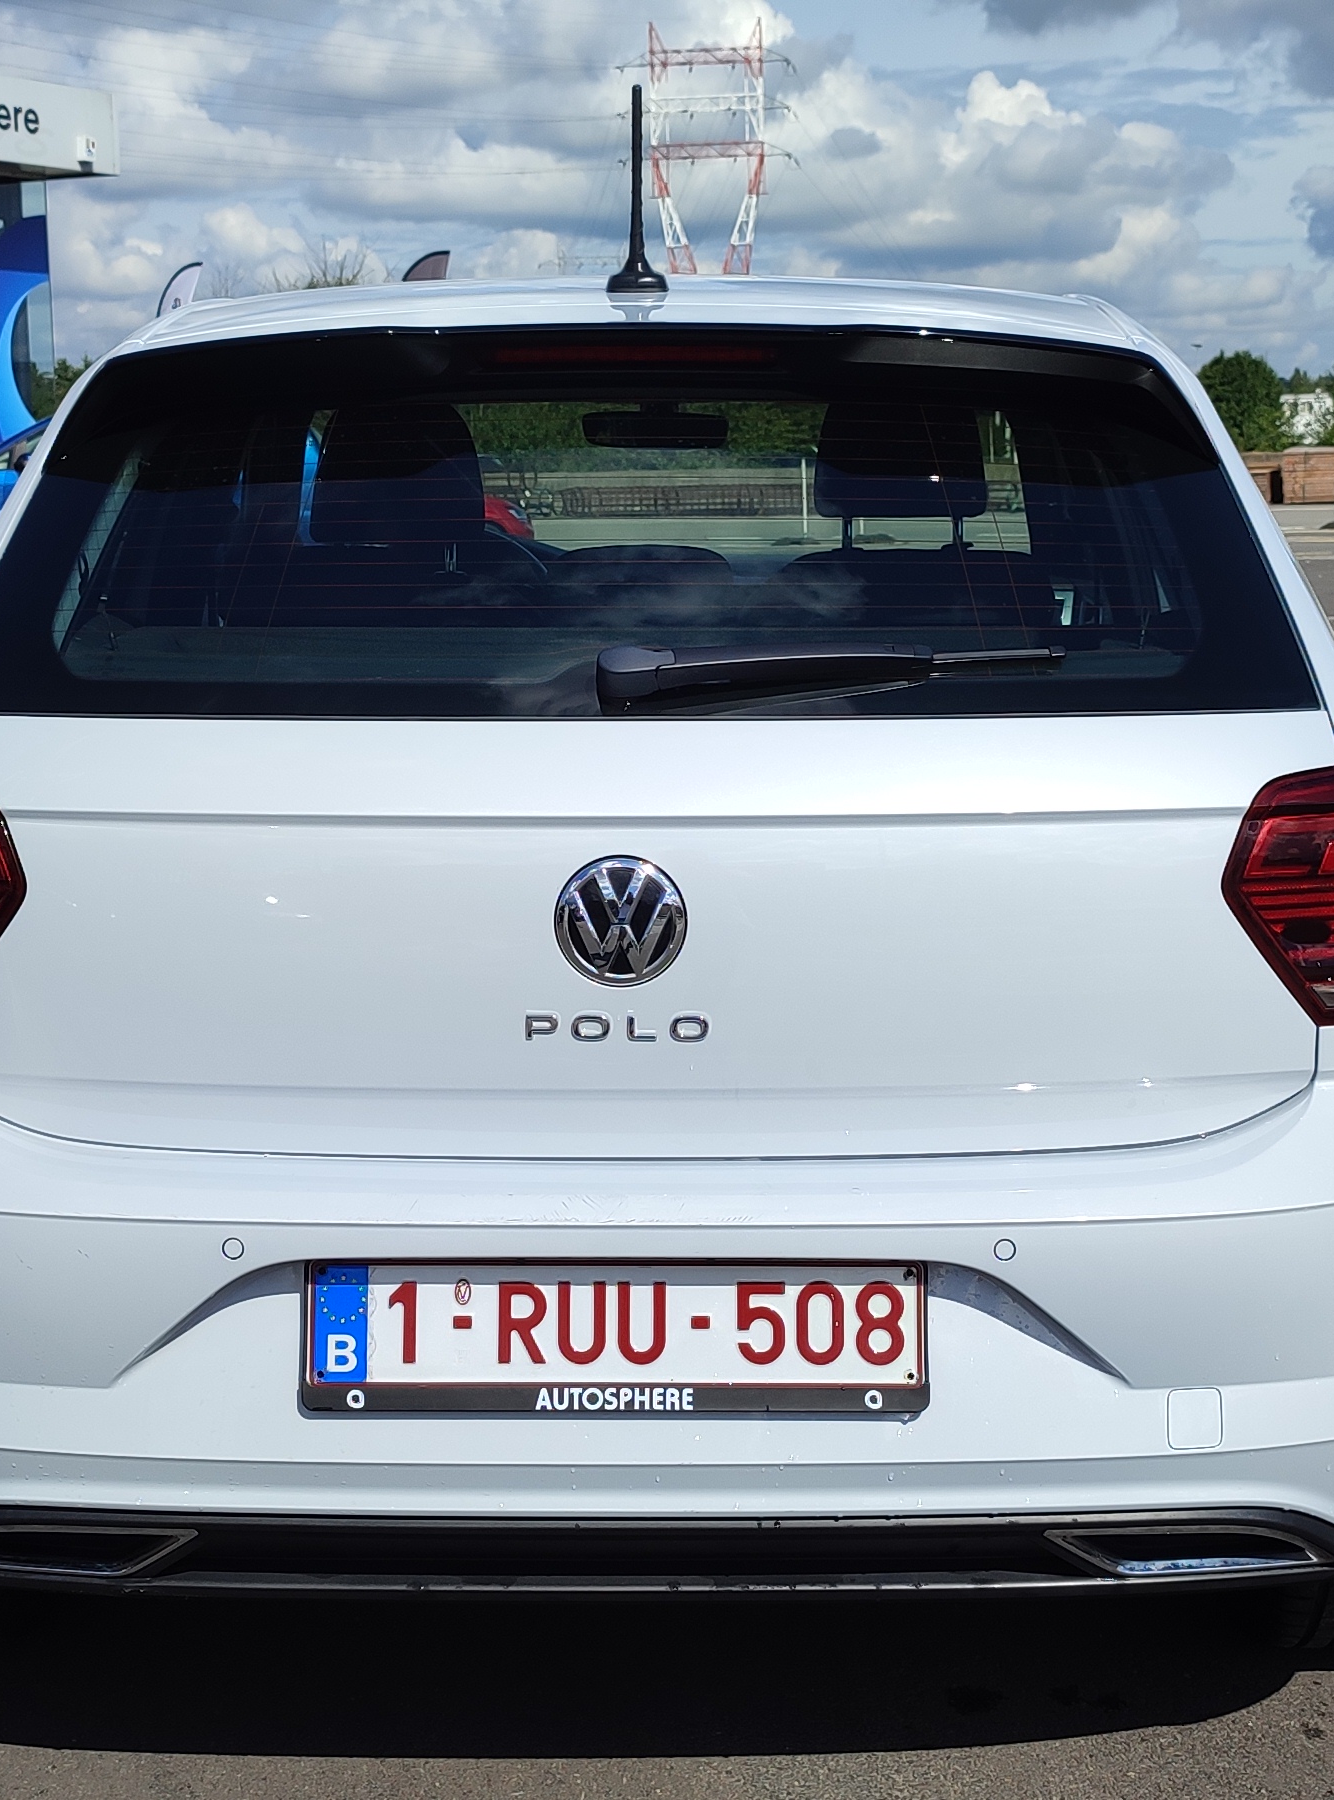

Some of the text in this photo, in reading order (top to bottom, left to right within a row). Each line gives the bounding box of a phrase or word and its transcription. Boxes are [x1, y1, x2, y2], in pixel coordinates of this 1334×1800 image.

[524, 1012, 711, 1044] POLO
[325, 1280, 905, 1373] B 1-RUU-508
[534, 1387, 695, 1412] AUTOSPHERE
